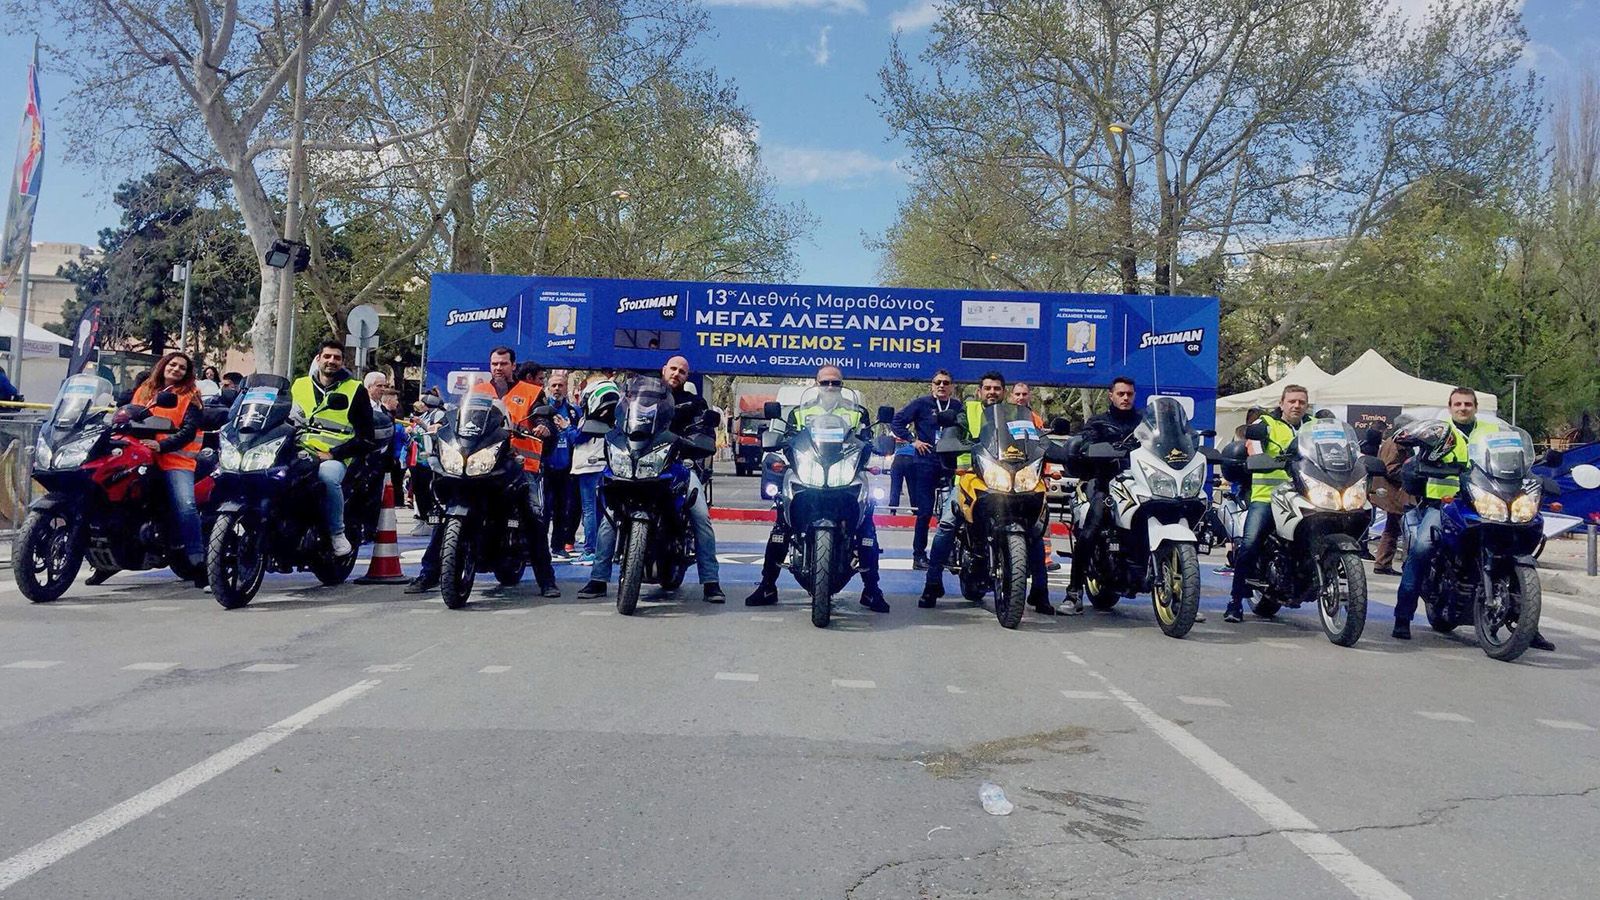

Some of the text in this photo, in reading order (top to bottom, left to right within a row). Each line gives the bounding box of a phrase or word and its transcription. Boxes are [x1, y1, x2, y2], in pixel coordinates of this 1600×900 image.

[616, 294, 678, 313] STOIXIMAN
[738, 291, 812, 310] Διεθνής
[816, 293, 935, 314] Μαραθώνιος
[446, 306, 508, 326] STOIXIMAN
[663, 309, 674, 317] GR
[492, 321, 504, 329] GR
[695, 310, 773, 328] ΜΕΓΑΣ
[780, 312, 945, 333] ΑΛΕΞΑΝΔΡΟΣ
[696, 331, 846, 351] ΤΕΡΜΑΤΙΣΜΟΣ
[869, 336, 941, 354] FINISH
[1139, 329, 1203, 349] STOIXIMAN
[1187, 344, 1199, 352] GR
[716, 353, 758, 365] ΠΕΛΛΑ
[769, 355, 854, 368] ΘΕΣΣΑΛΟΝΙΚΗ
[868, 361, 902, 369] ΑΠΡΙΛΙΟΥ
[903, 362, 920, 370] 2018
[1354, 421, 1368, 429] For
[1361, 414, 1387, 422] Timing
